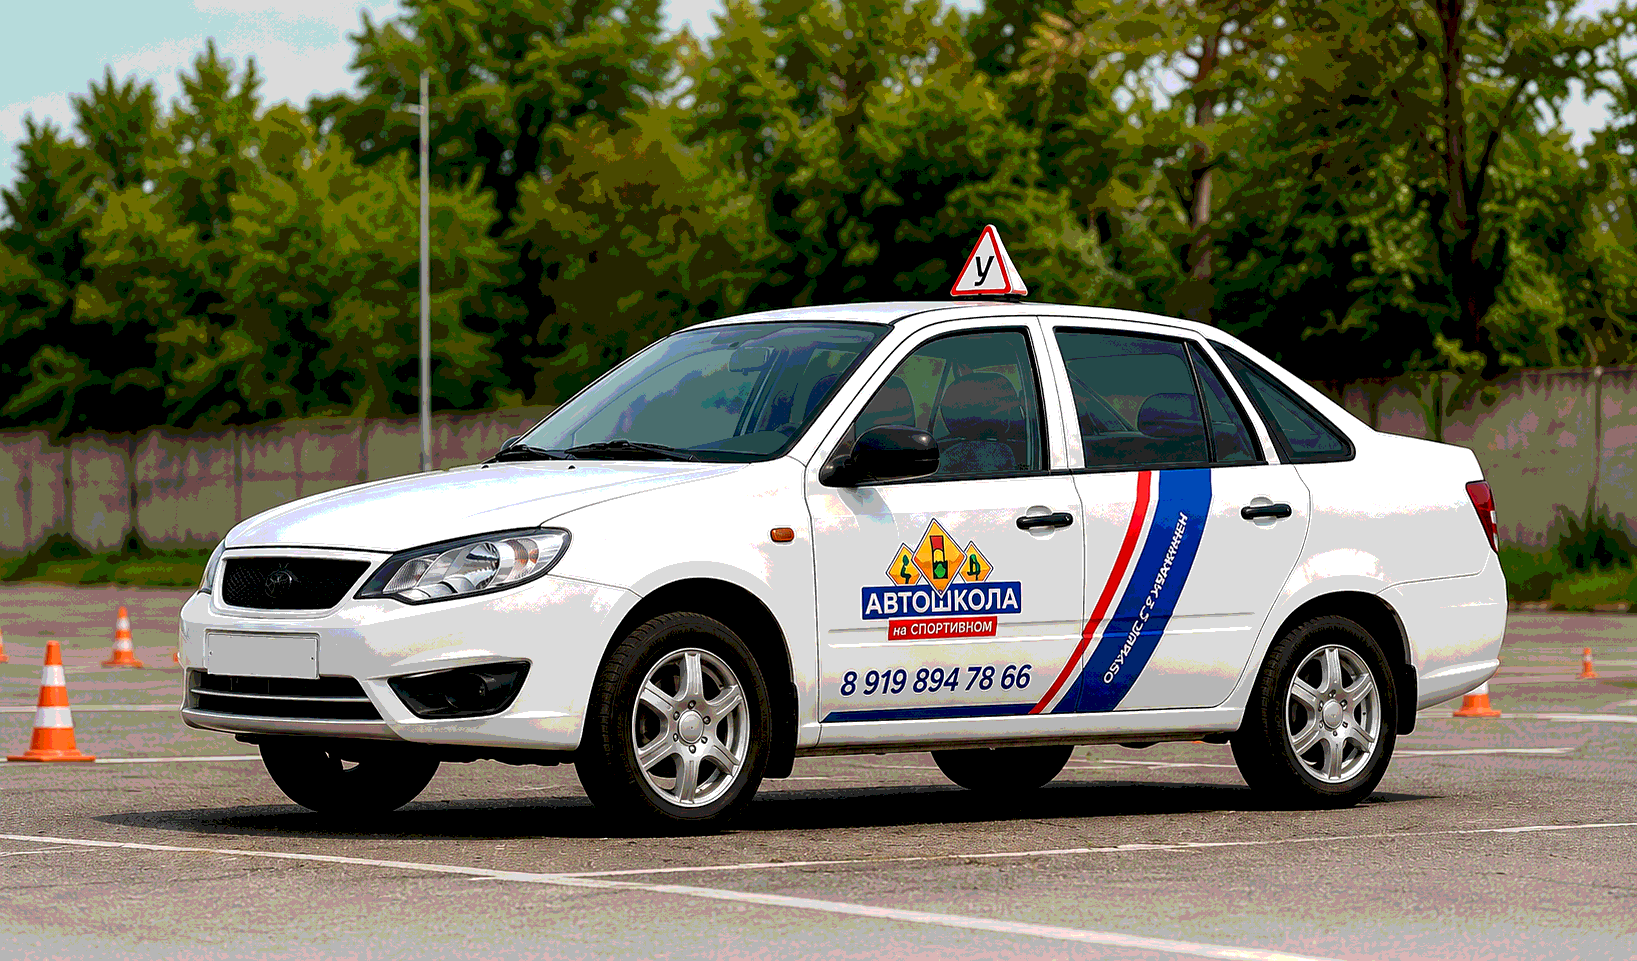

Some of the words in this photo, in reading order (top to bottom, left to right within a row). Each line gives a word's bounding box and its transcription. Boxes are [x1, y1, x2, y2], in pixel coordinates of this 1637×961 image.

[974, 256, 994, 286] У
[865, 587, 1019, 615] АВТОШКОЛА
[893, 625, 907, 636] на
[910, 620, 993, 635] СПОРТИВНОМ
[840, 670, 858, 697] 8
[863, 668, 908, 695] 919
[913, 666, 960, 693] 894
[965, 665, 996, 691] 78
[1000, 663, 1032, 690] 66
